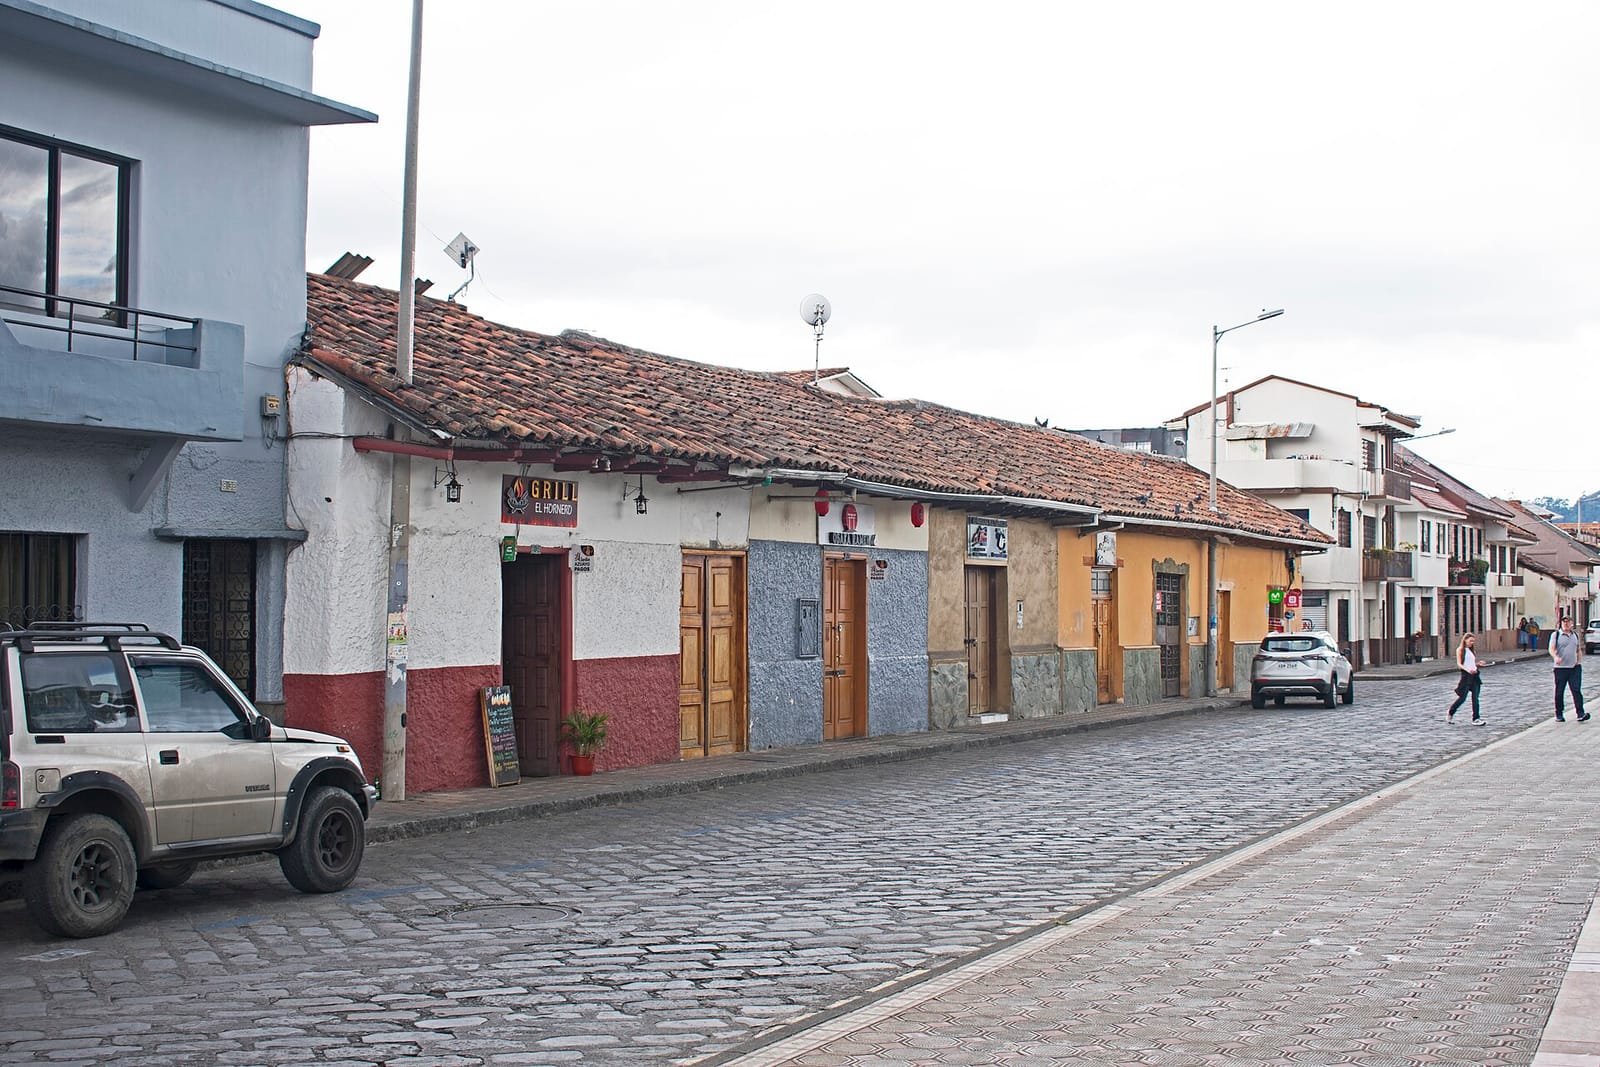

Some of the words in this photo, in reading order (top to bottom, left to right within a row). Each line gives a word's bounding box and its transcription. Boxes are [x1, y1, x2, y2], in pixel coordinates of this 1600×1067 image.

[531, 479, 578, 501] GRILL
[535, 502, 543, 513] EL
[543, 503, 573, 515] HORNERO
